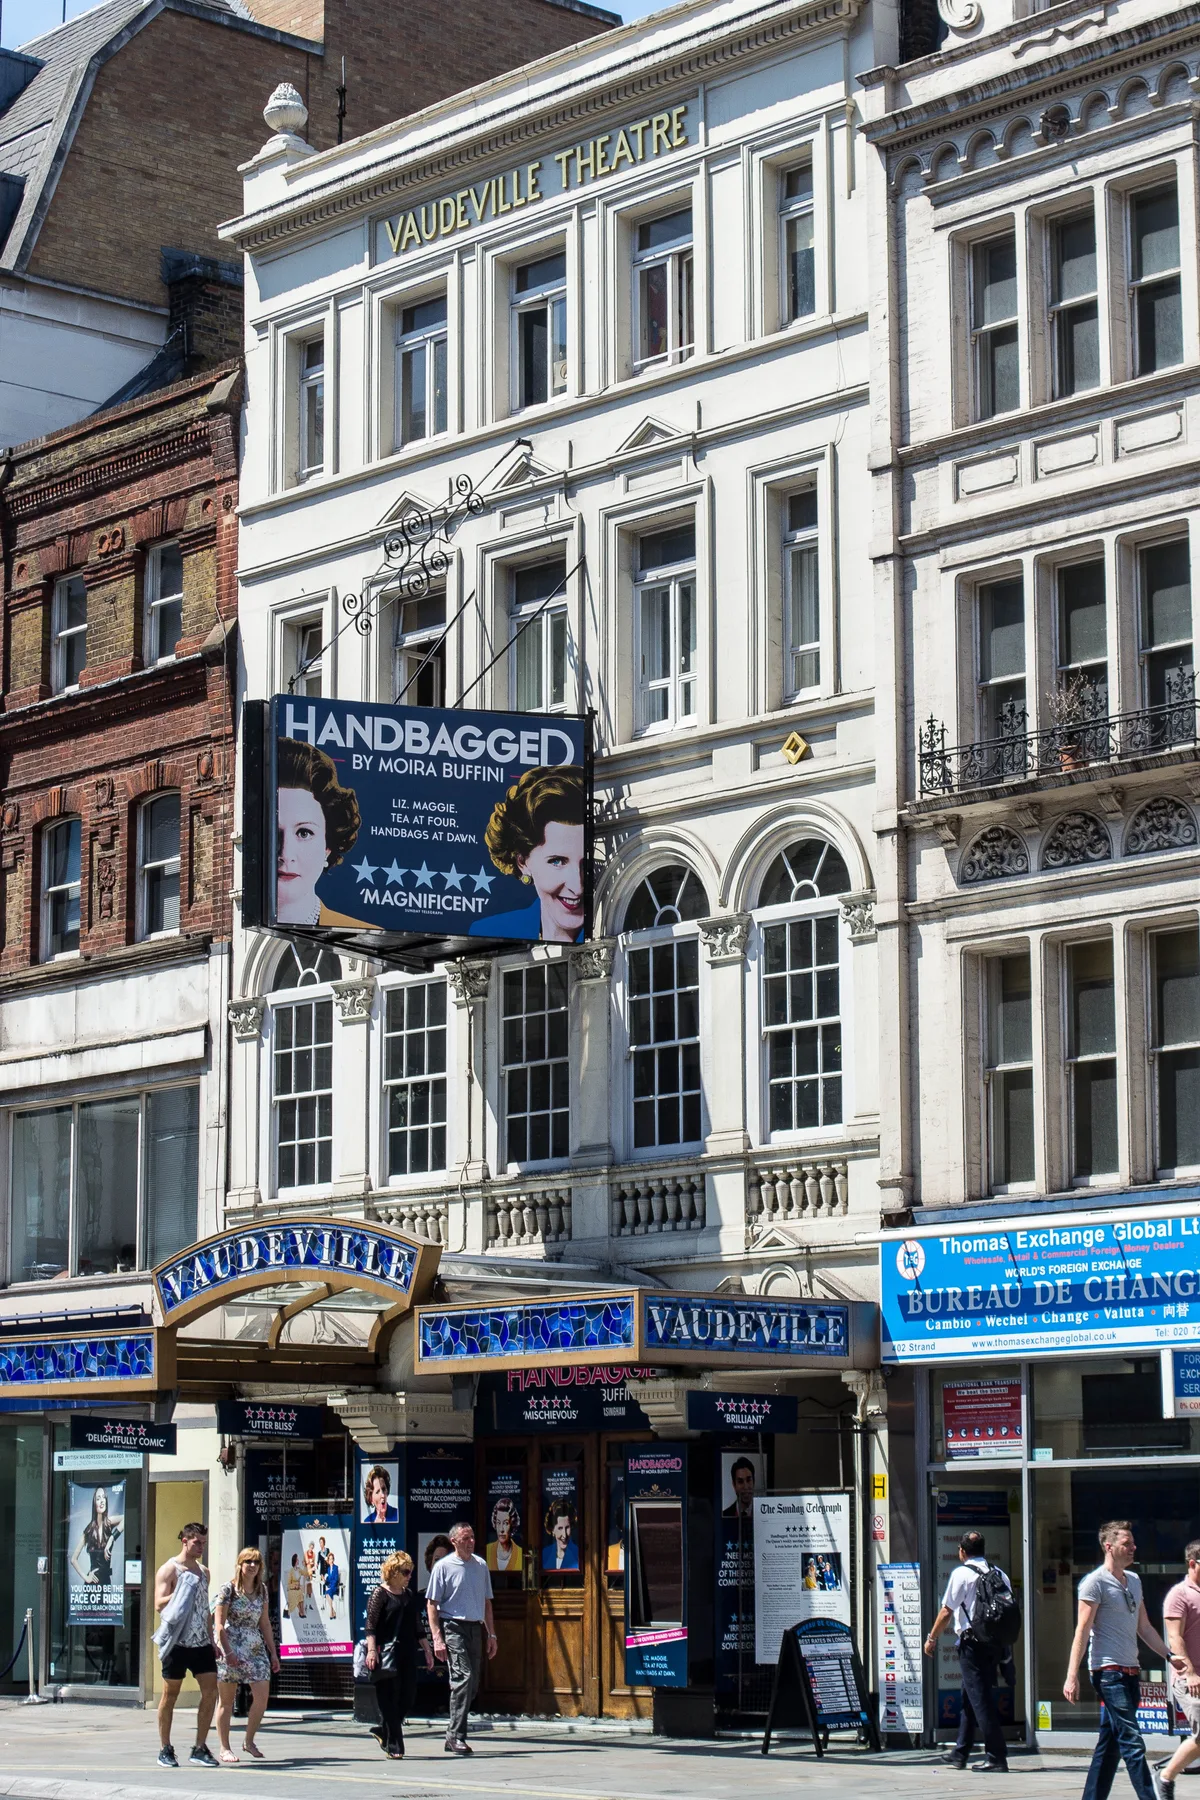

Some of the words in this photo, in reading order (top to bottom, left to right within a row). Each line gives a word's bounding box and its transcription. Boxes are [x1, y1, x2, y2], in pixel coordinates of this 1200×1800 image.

[384, 161, 541, 252] VAUDEVILLE
[554, 105, 688, 188] THEATRE
[285, 703, 576, 767] HANDBAGGED
[352, 754, 374, 771] BY
[378, 755, 437, 778] MOIRA
[442, 763, 504, 783] BUFFINI
[392, 798, 410, 809] LIZ.
[412, 801, 458, 813] MAGGIE.
[391, 813, 410, 824] TEA
[412, 815, 425, 826] AT
[427, 816, 460, 829] FOUR.
[371, 826, 429, 841] HANDBAGS
[431, 830, 445, 842] AT
[447, 832, 479, 845] DAWN.
[359, 887, 490, 913] 'MAGNIFICENT'
[939, 1236, 1009, 1255] Thomas
[1016, 1228, 1105, 1249] Exchange
[1112, 1219, 1173, 1241] Global
[1041, 1246, 1088, 1259] Commercial
[1090, 1245, 1120, 1256] Foreign
[1123, 1243, 1150, 1253] Money
[1153, 1241, 1185, 1250] Dealers
[163, 1227, 410, 1301] VAUDEVILLE
[1005, 1267, 1046, 1278] WORLD'S
[1049, 1262, 1088, 1275] FOREIGN
[1091, 1258, 1142, 1271] EXCHANGE
[907, 1282, 1022, 1314] BUREAU
[1033, 1278, 1073, 1306] DE
[1084, 1268, 1200, 1302] CHANG
[648, 1305, 845, 1347] VAUDEVILLE
[925, 1316, 971, 1331] Cambio
[985, 1313, 1028, 1327] Wechel
[1041, 1310, 1089, 1325] Change
[1104, 1305, 1144, 1319] Valuta
[971, 1330, 1117, 1349] www.thomasexchangeglobal.co.uk
[1155, 1327, 1170, 1338] Tel:
[1173, 1326, 1189, 1336] 020
[909, 1342, 936, 1352] Strand
[628, 1457, 682, 1470] HANDBAGGED
[760, 1503, 775, 1514] The
[777, 1503, 805, 1516] Sunday
[806, 1502, 842, 1515] Telegraph
[718, 1570, 728, 1578] OF
[70, 1594, 89, 1604] FACE
[90, 1594, 101, 1603] OF
[103, 1594, 123, 1603] RUSH
